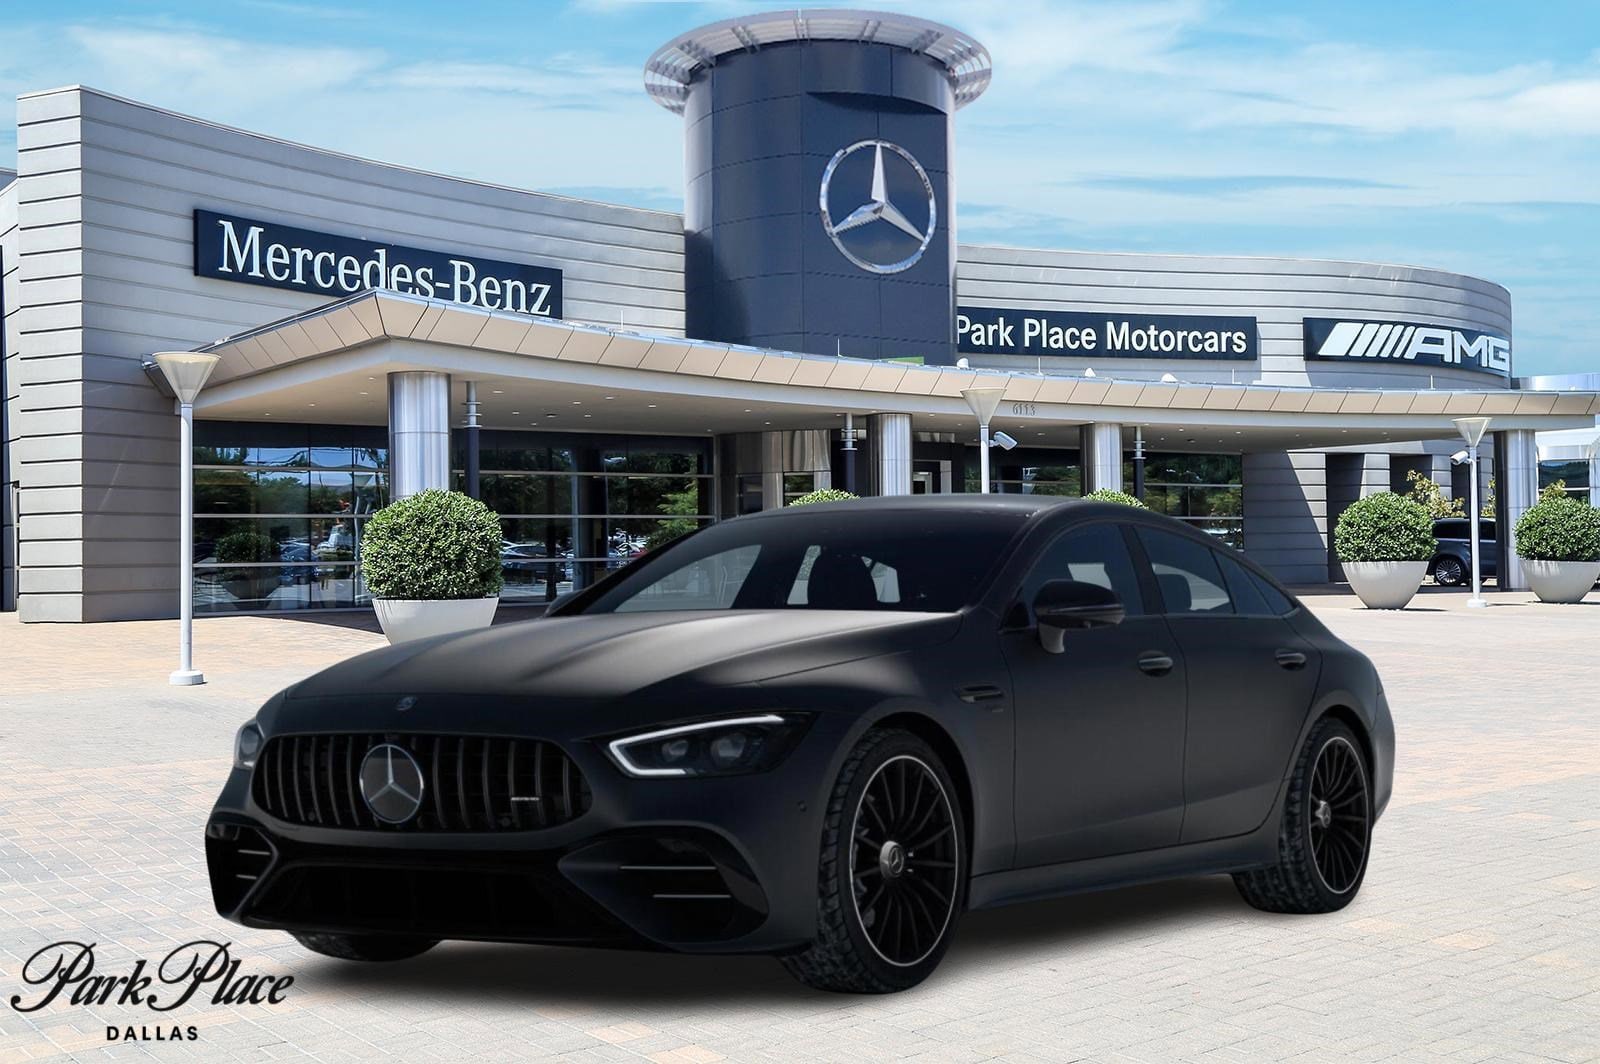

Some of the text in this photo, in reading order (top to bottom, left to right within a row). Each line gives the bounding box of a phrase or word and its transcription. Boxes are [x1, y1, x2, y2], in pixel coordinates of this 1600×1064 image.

[218, 219, 552, 316] Mercedes-Benz
[957, 315, 1248, 354] Park Place Motorcars
[1012, 402, 1036, 416] 6113
